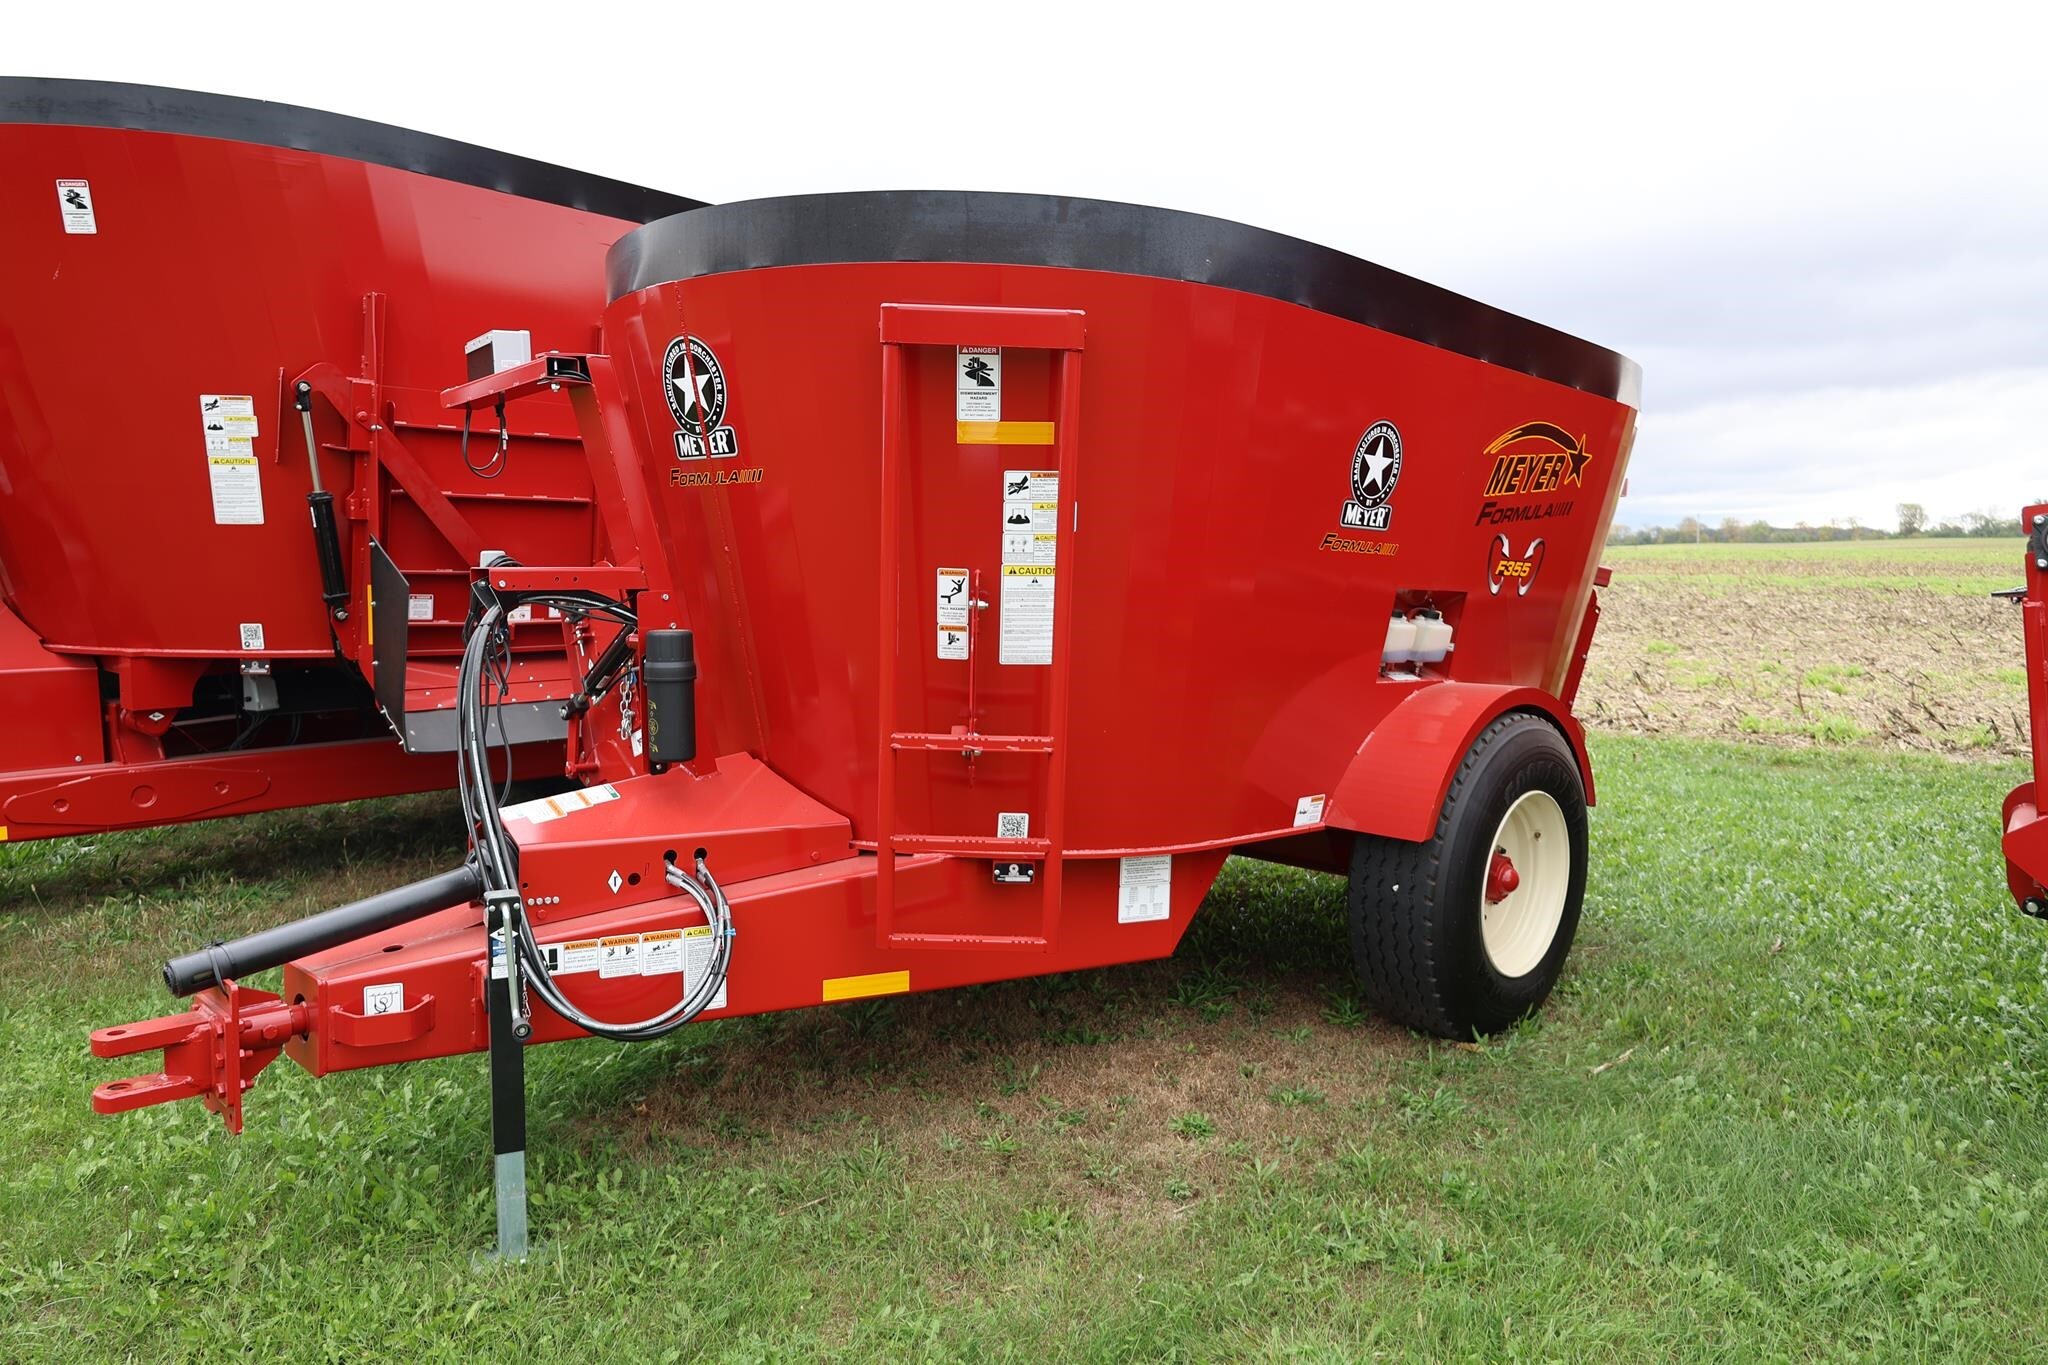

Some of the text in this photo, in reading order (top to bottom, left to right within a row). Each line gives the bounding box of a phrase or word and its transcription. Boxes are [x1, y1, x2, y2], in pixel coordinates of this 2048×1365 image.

[677, 430, 730, 457] MEYER
[1484, 453, 1567, 497] MEYER
[1344, 503, 1387, 528] MEYER
[1495, 560, 1532, 577] F355
[607, 936, 639, 946] WARNING
[650, 931, 680, 941] WARNING
[570, 941, 597, 949] WARNING
